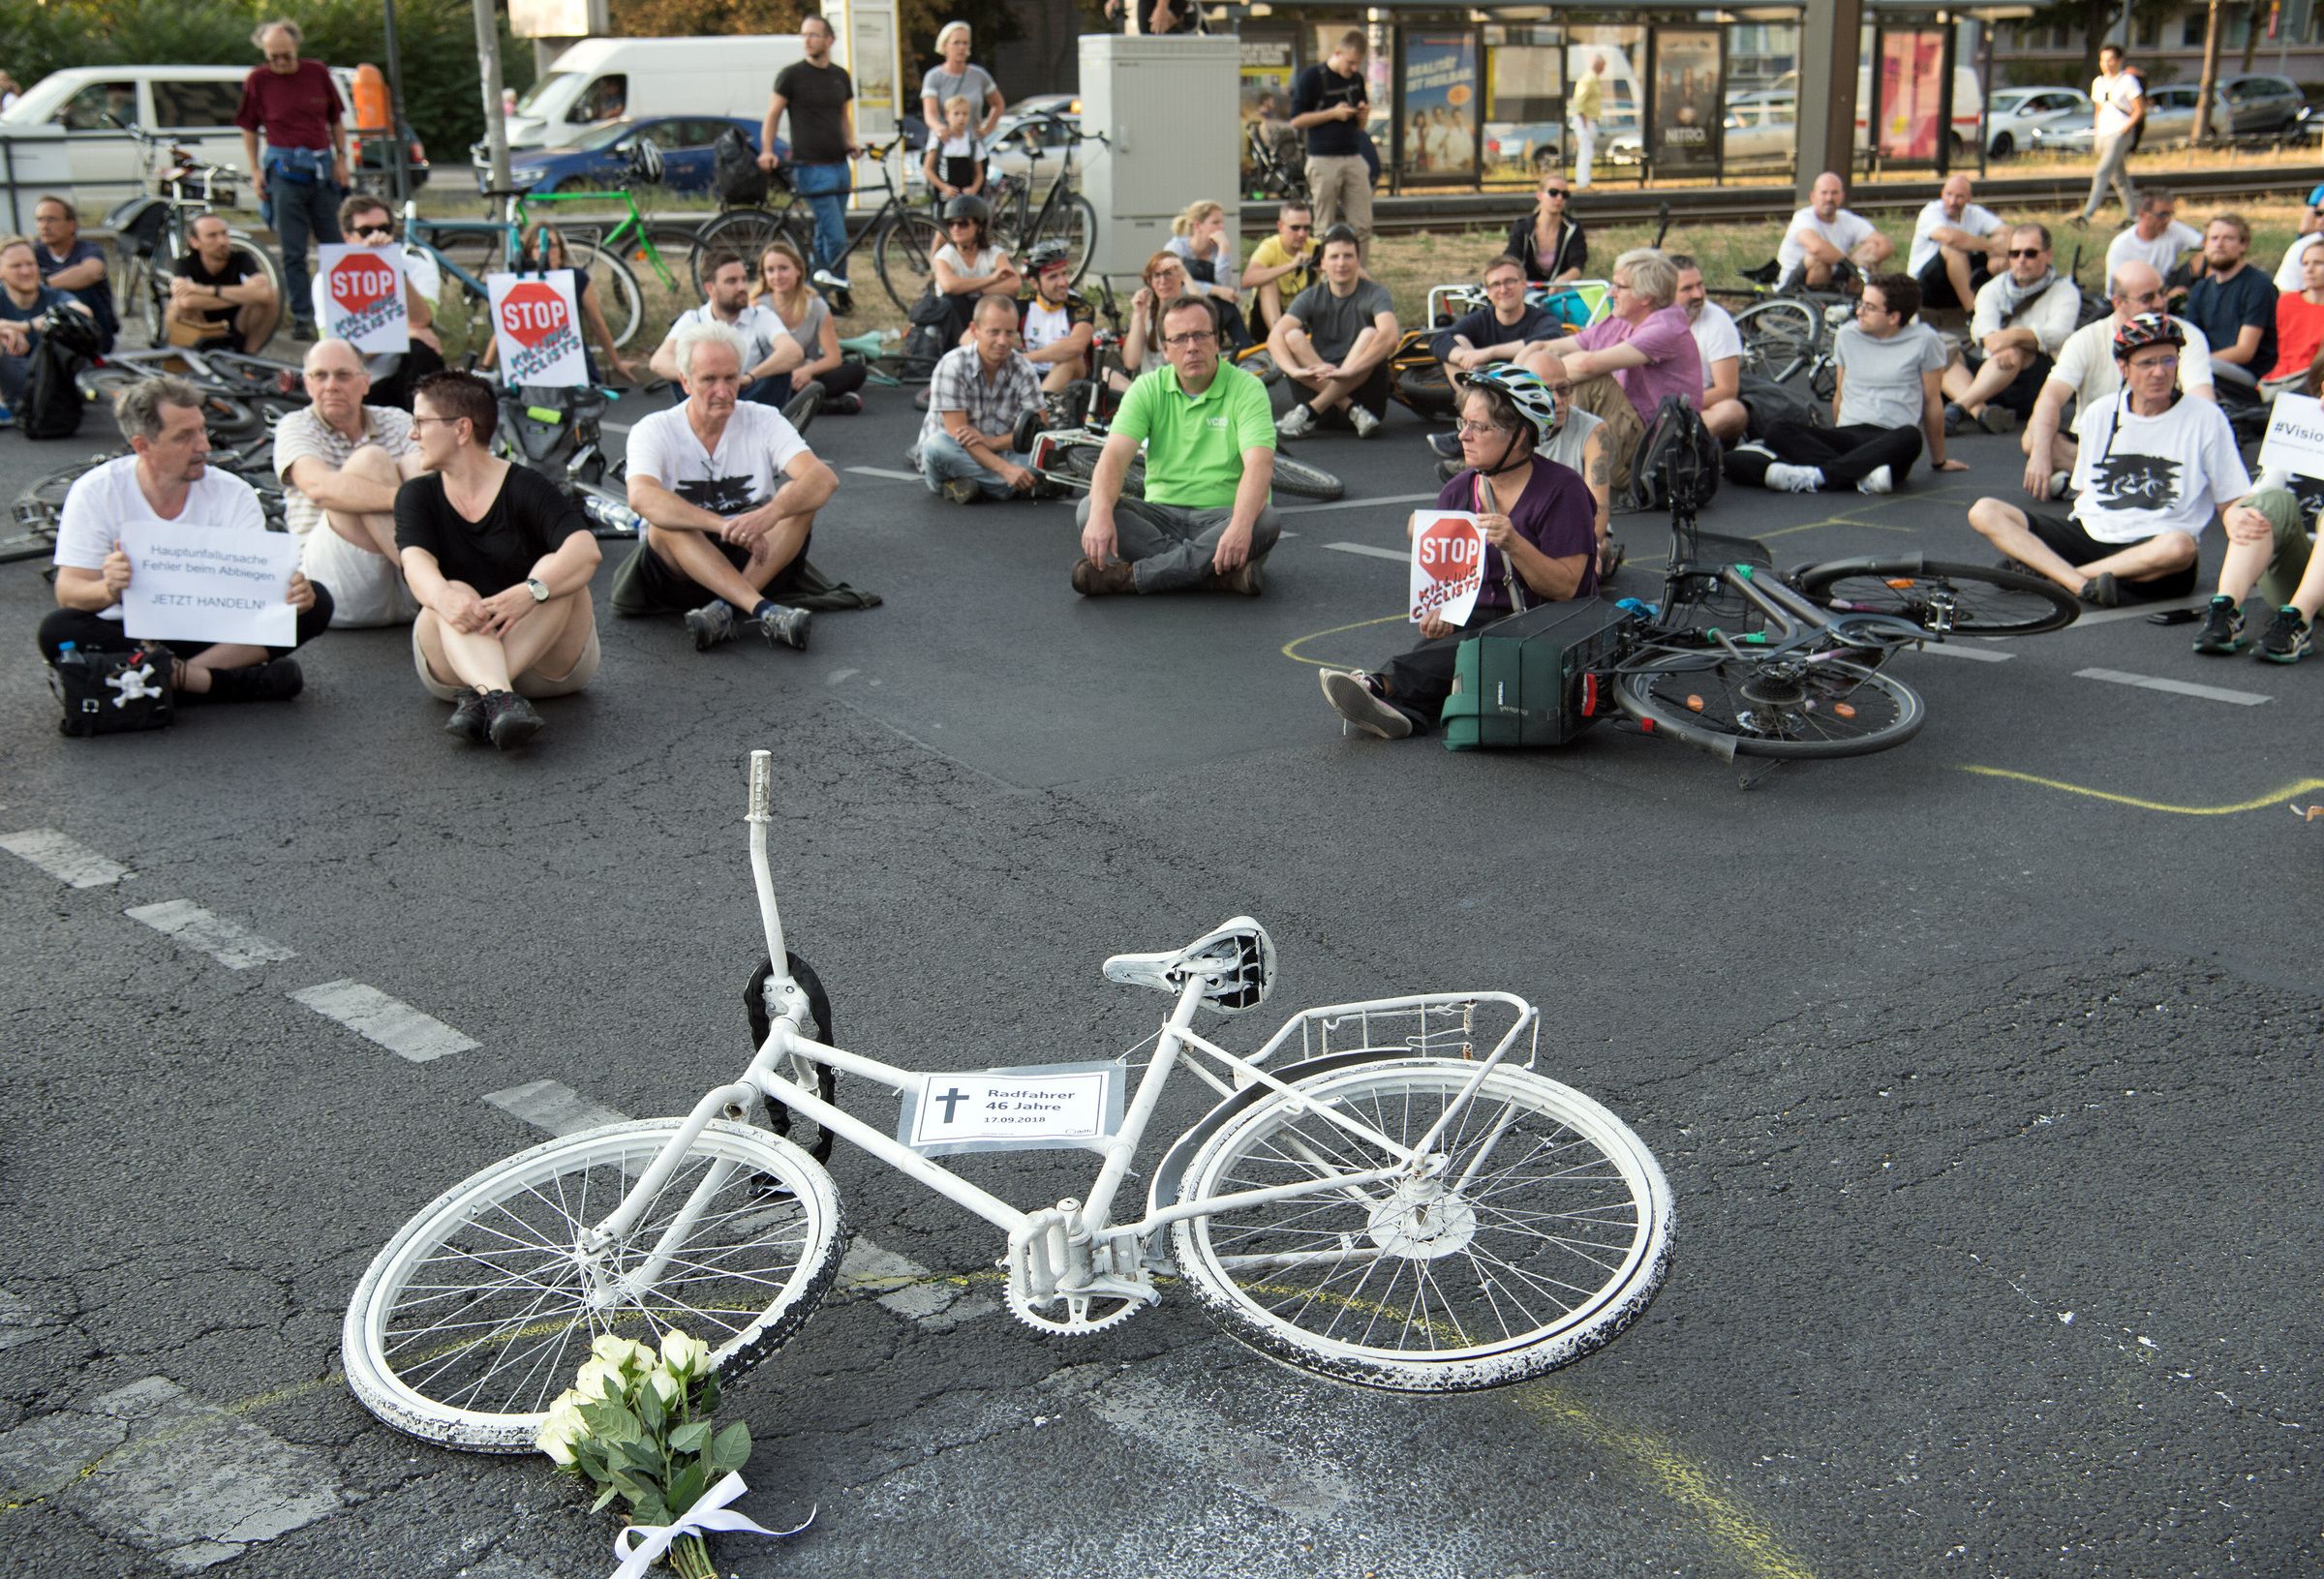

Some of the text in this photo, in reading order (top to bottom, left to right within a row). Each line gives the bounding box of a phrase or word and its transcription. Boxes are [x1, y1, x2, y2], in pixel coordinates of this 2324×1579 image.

[332, 270, 393, 297] STOP
[341, 303, 405, 341] YCLISTS
[504, 300, 565, 331] STOP
[510, 323, 571, 369] KILLING
[150, 544, 268, 565] Hauptunfallursache
[1422, 537, 1479, 565] STOP
[142, 560, 276, 581] Fehler beim Abbiegen
[1419, 565, 1478, 602] KILLING
[152, 593, 266, 611] JETZT HANDELN!
[1411, 576, 1481, 620] CYCLISTS
[985, 1102, 1062, 1111] 46 Jahre
[988, 1089, 1076, 1100] Radfahrer
